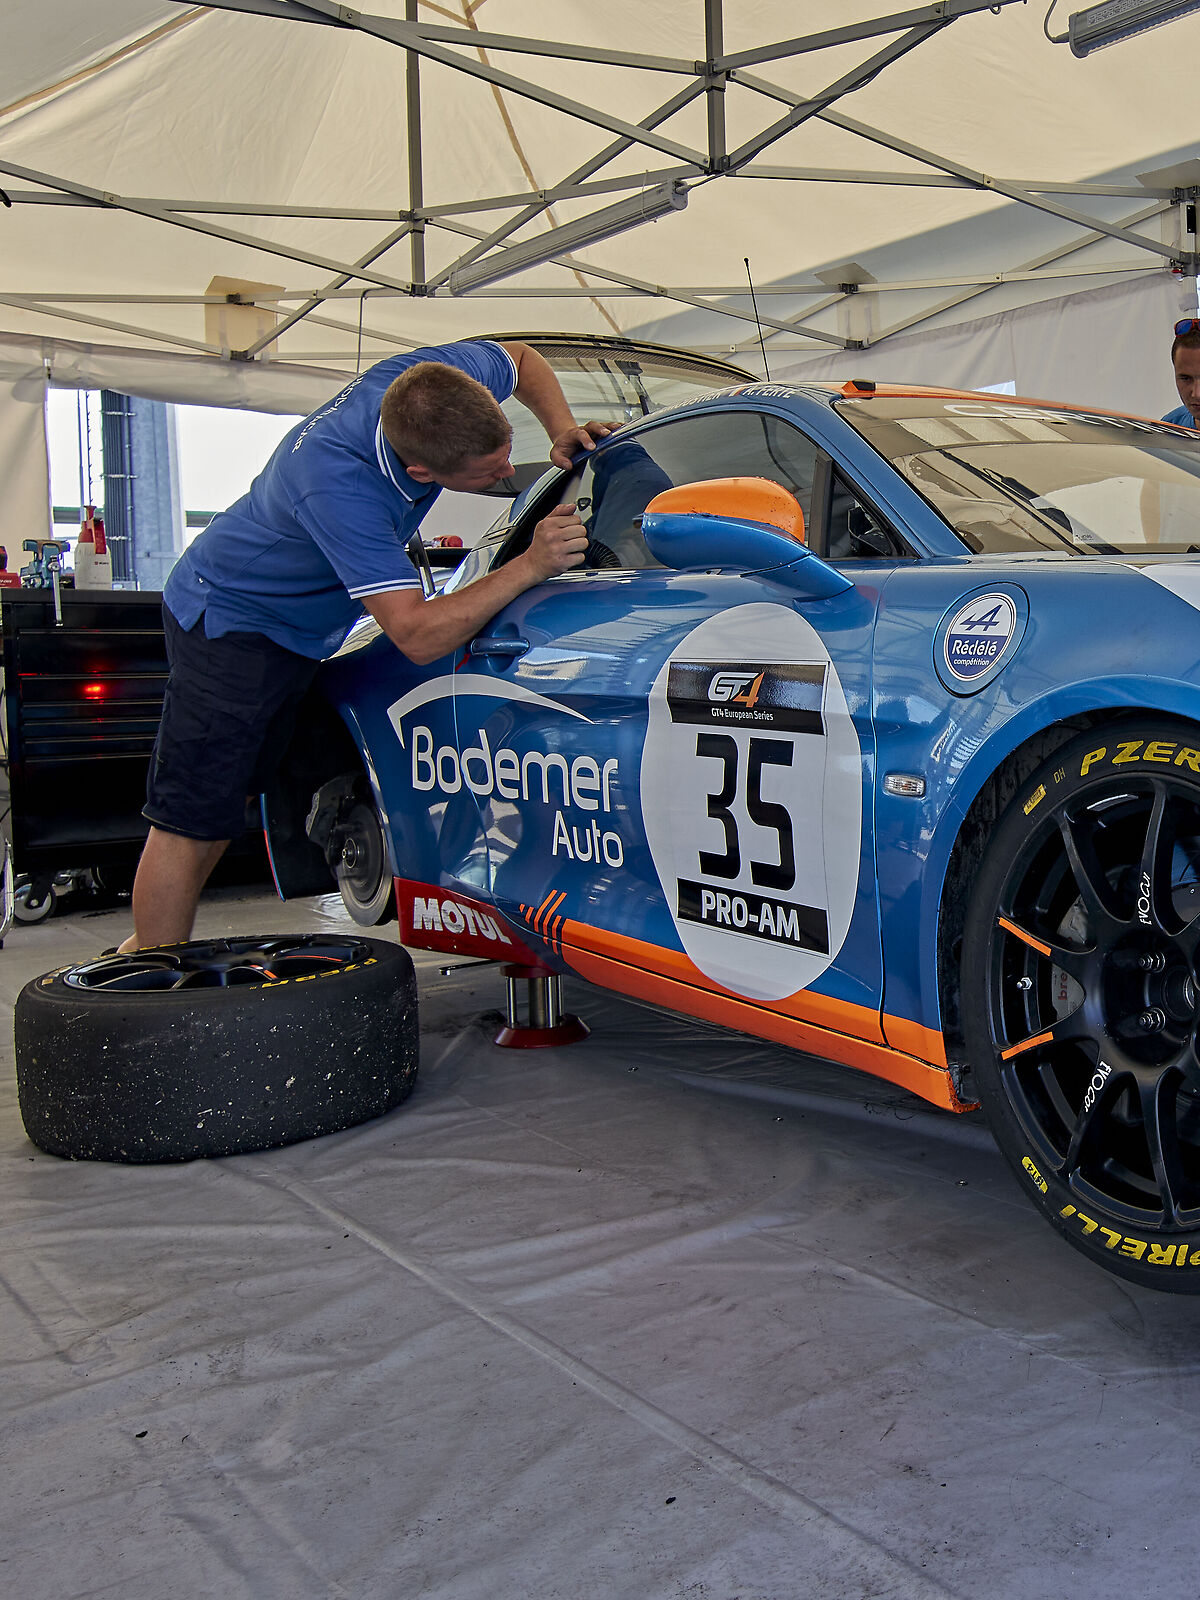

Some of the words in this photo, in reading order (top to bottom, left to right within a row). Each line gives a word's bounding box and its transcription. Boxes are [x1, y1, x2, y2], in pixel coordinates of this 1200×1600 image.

[952, 640, 997, 656] Rédélé
[707, 671, 765, 708] GT4
[725, 709, 753, 721] European
[754, 710, 774, 721] Series
[412, 725, 619, 813] Bodemer
[1080, 746, 1107, 777] P
[695, 732, 797, 892] 35
[552, 810, 625, 868] Auto
[413, 897, 513, 945] MOTUL
[701, 889, 801, 942] PRO-AM
